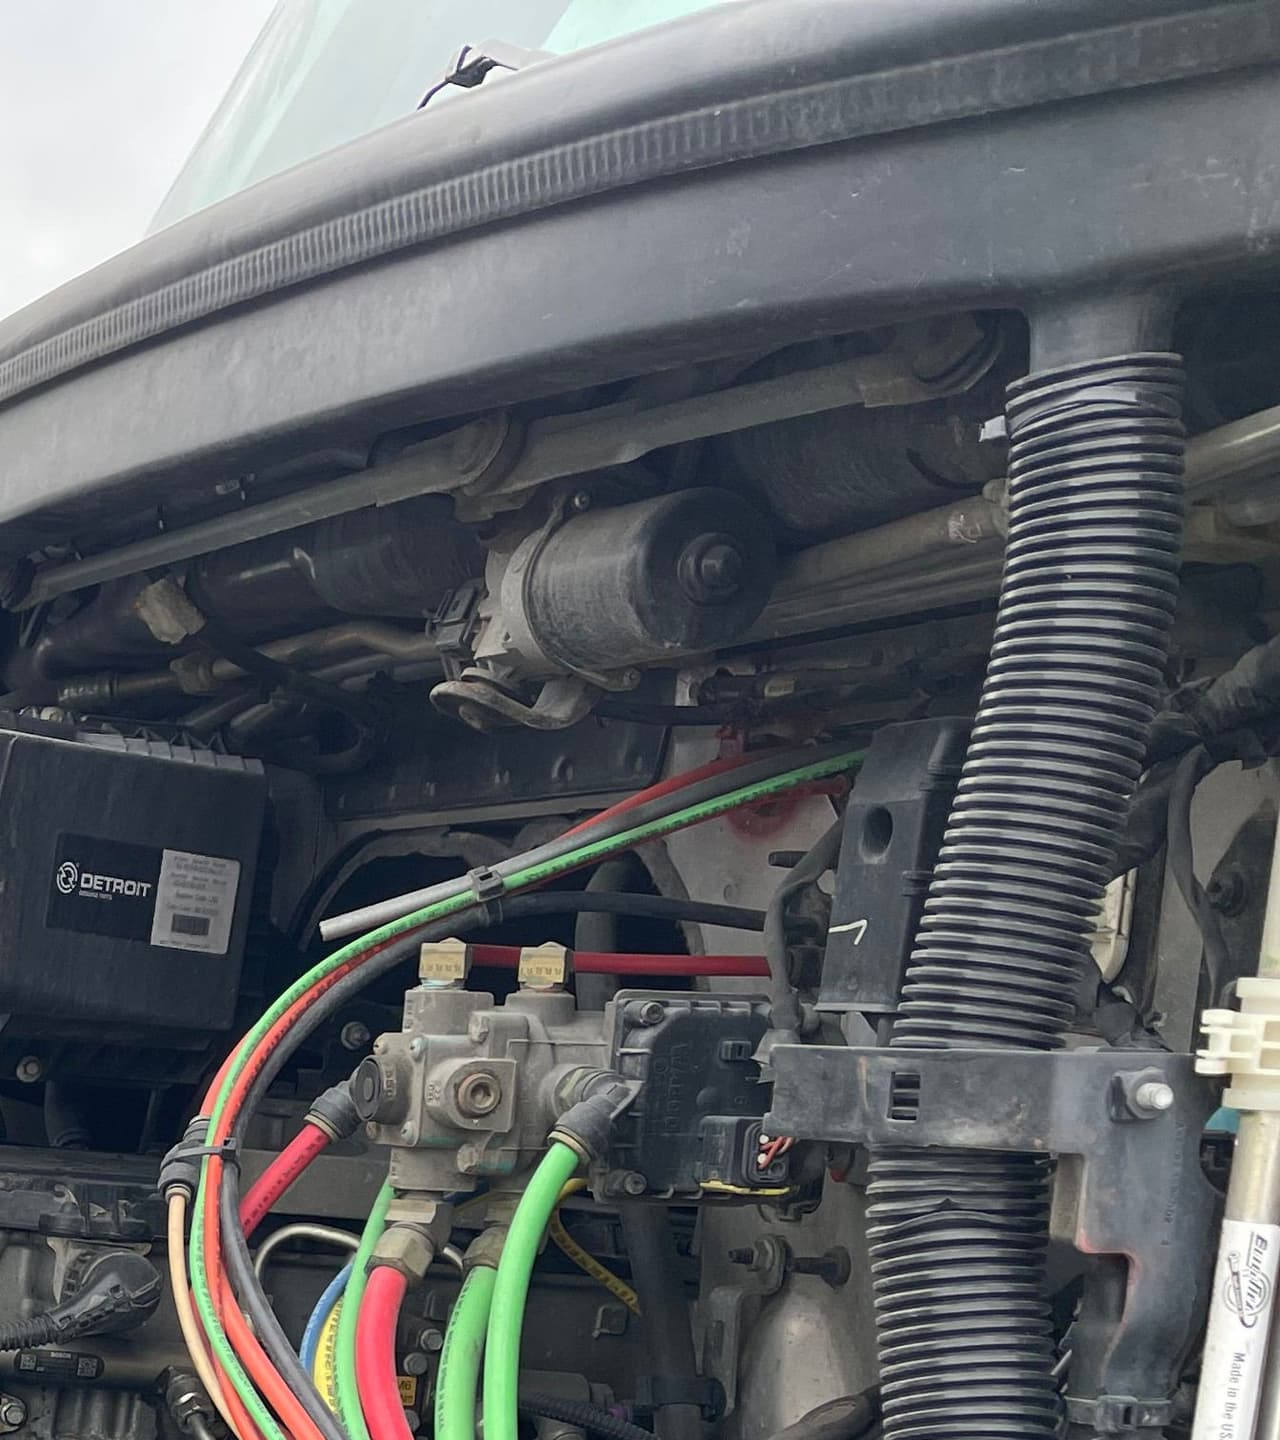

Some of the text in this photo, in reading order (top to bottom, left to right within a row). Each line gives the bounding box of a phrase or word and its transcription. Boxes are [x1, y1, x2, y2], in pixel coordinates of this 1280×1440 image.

[80, 873, 152, 897] DETROIT
[1229, 1352, 1246, 1384] Made
[1227, 1387, 1240, 1398] in
[1223, 1402, 1238, 1420] the
